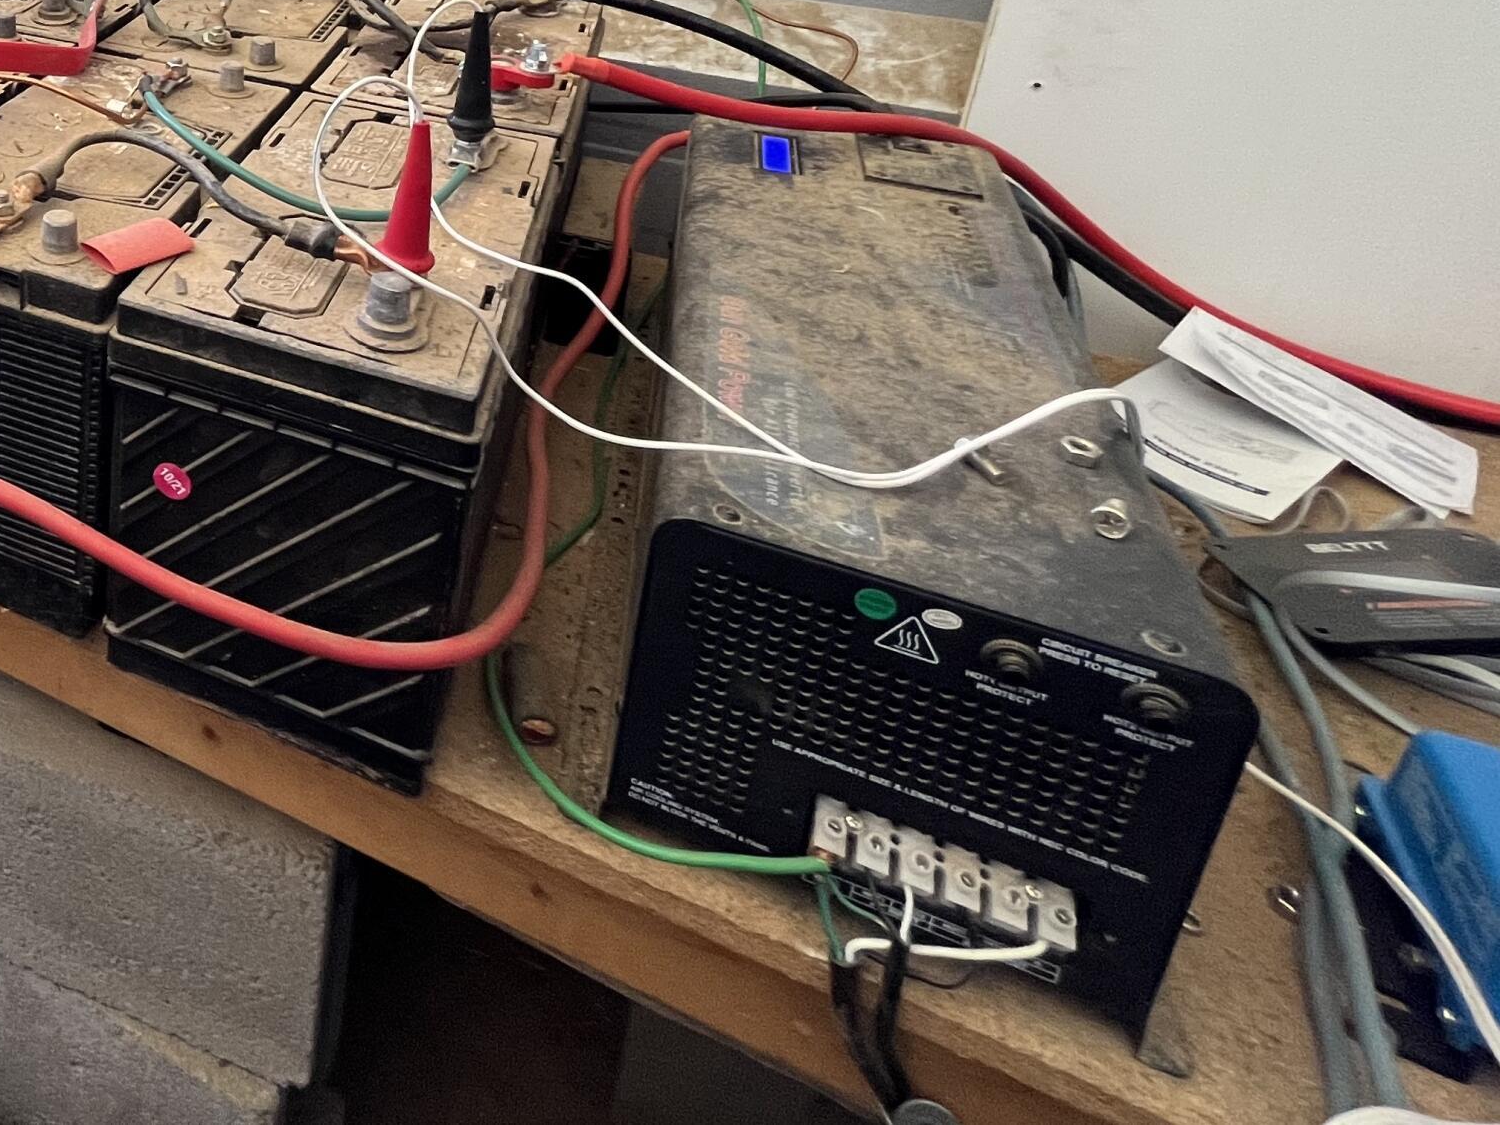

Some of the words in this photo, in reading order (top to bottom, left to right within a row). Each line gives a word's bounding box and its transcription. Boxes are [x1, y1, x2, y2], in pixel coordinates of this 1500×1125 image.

[717, 366, 751, 427] Powr
[160, 467, 186, 495] 10/21
[1037, 646, 1080, 666] PRESS
[1084, 660, 1102, 672] TO
[1102, 666, 1148, 685] RESET
[1040, 637, 1093, 659] CIRCUIT
[1093, 652, 1158, 678] BREAKER
[976, 682, 1034, 707] PROTECT
[1114, 727, 1177, 752] PROTECT
[641, 796, 659, 808] NOT
[660, 804, 689, 820] BLOCK
[690, 815, 707, 826] THE
[771, 738, 793, 751] USE
[793, 747, 867, 778] APPROPRIATE
[868, 774, 893, 788] SIZE
[950, 804, 966, 814] OF
[1006, 825, 1038, 842] WITH
[1065, 847, 1109, 868] COLOR
